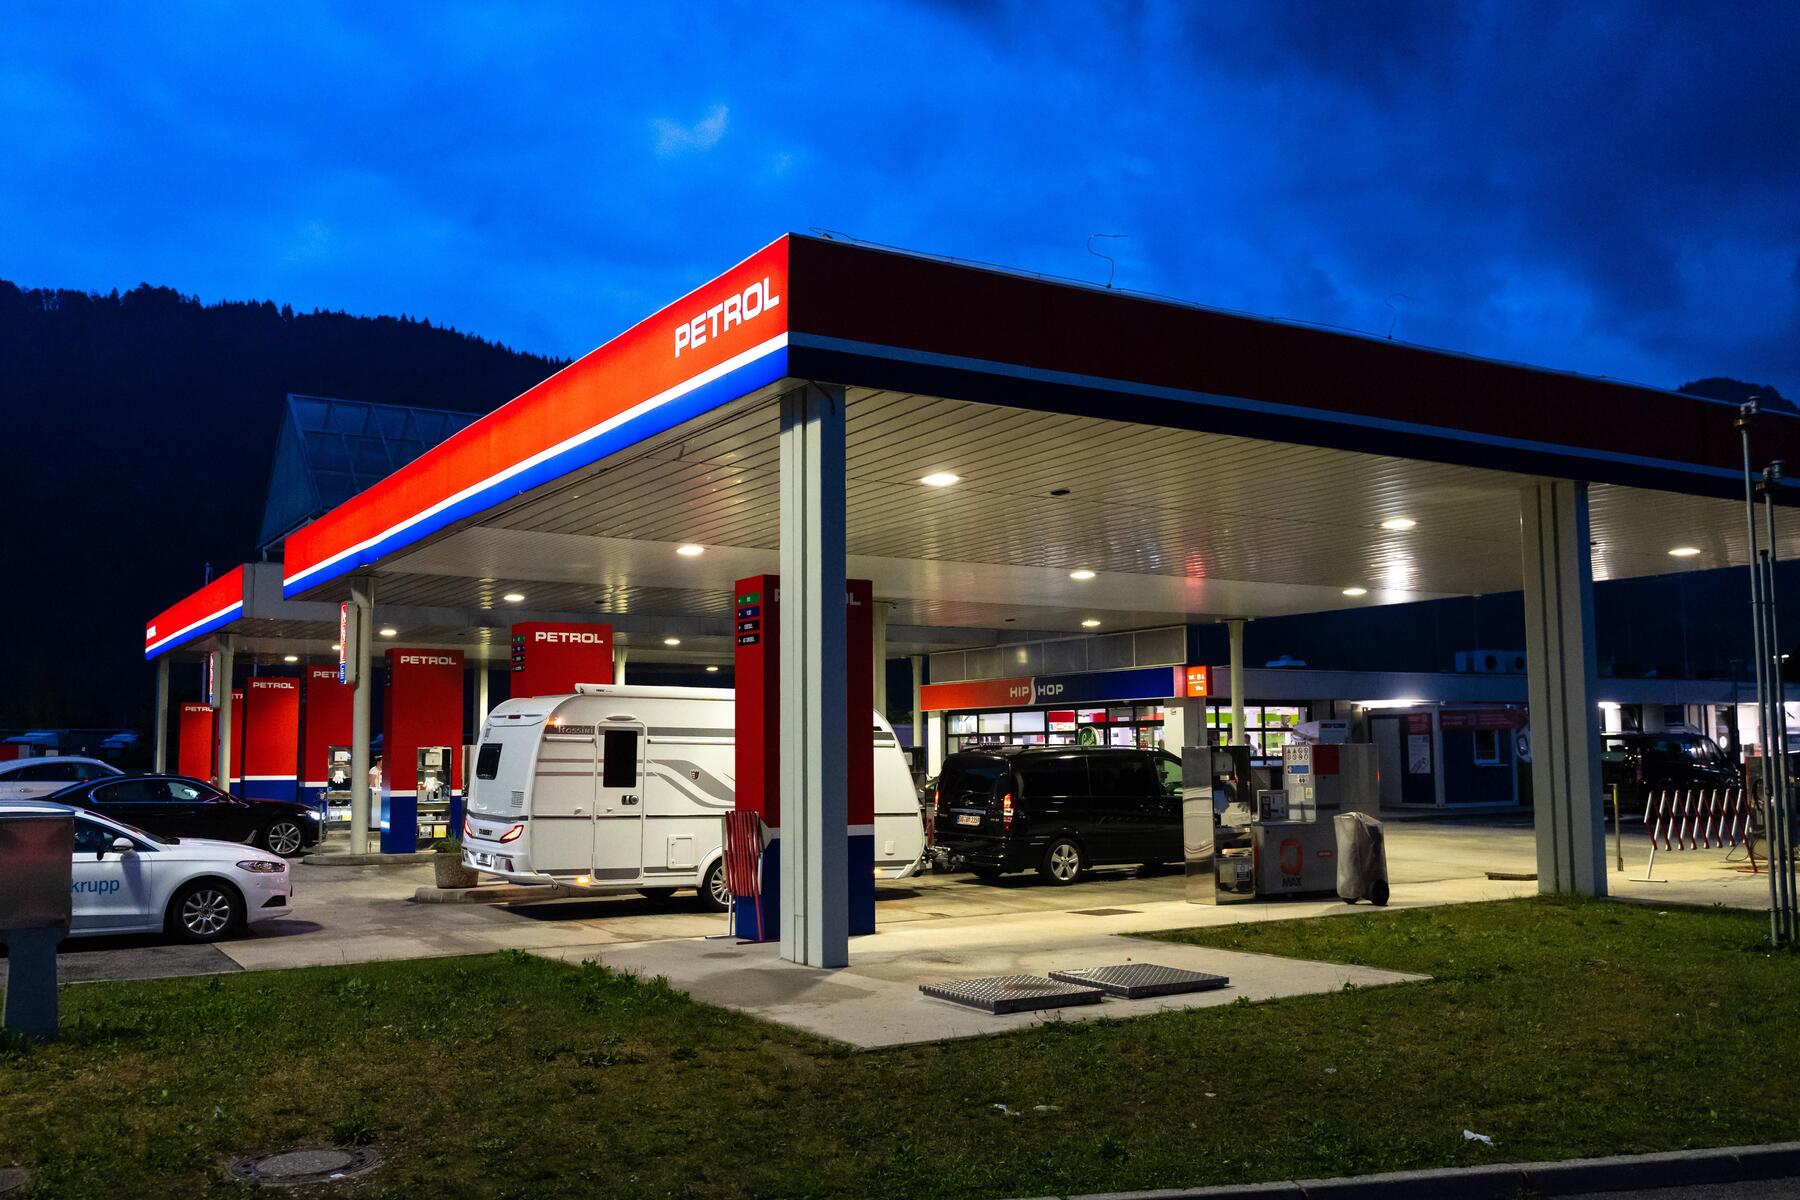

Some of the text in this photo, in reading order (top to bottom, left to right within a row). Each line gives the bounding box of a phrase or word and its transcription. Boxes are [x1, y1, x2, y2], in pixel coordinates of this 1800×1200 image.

[674, 277, 780, 358] PETROL
[535, 631, 604, 644] PETROL
[400, 655, 457, 665] PETROL
[252, 681, 294, 689] PETROL
[1010, 686, 1030, 698] HIP
